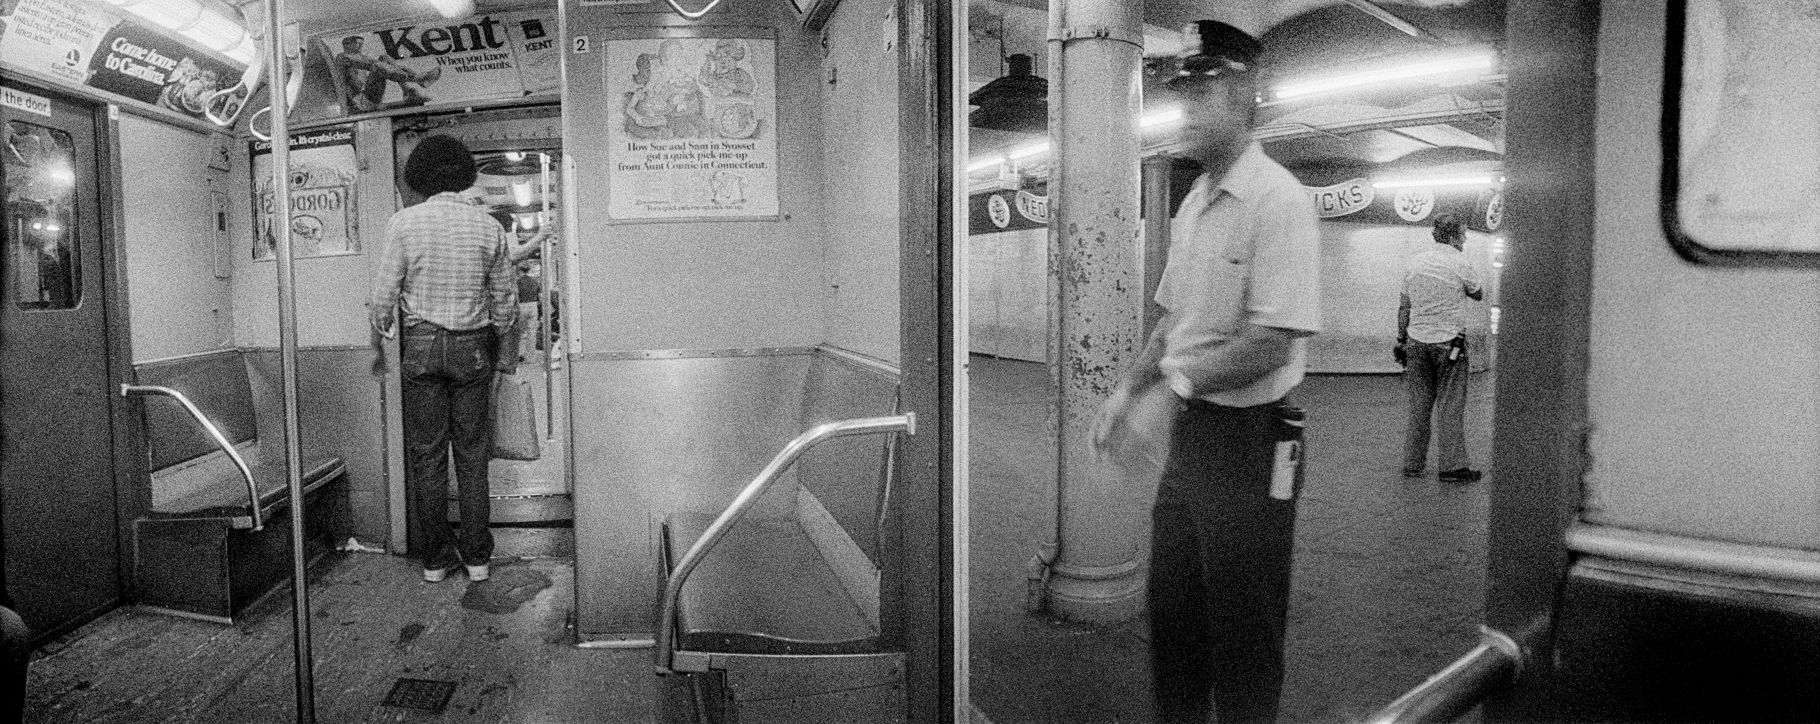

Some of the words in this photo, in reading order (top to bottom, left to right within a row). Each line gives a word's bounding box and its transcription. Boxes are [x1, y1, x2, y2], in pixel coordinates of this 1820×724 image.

[373, 16, 505, 60] Kent
[525, 39, 553, 52] KENT
[576, 39, 586, 51] 2
[111, 37, 148, 60] Come
[144, 48, 178, 71] home
[436, 55, 464, 66] When
[465, 54, 482, 65] you
[483, 51, 510, 61] know
[105, 52, 120, 70] to
[119, 57, 165, 86] Carolina.
[455, 63, 478, 73] what
[479, 61, 512, 71] counts.
[5, 91, 22, 106] the
[627, 142, 648, 152] How
[650, 142, 668, 152] Sue
[669, 141, 686, 151] and
[688, 141, 709, 151] Sam
[710, 141, 720, 150] in
[721, 141, 756, 152] Syosset
[646, 153, 661, 161] got
[670, 151, 695, 162] quick
[618, 163, 642, 172] from
[643, 162, 664, 171] Aunt
[666, 161, 698, 170] Connie
[700, 159, 710, 170] in
[711, 160, 768, 170] Connecticut.
[1315, 186, 1363, 211] ICKS
[1022, 197, 1046, 218] NED
